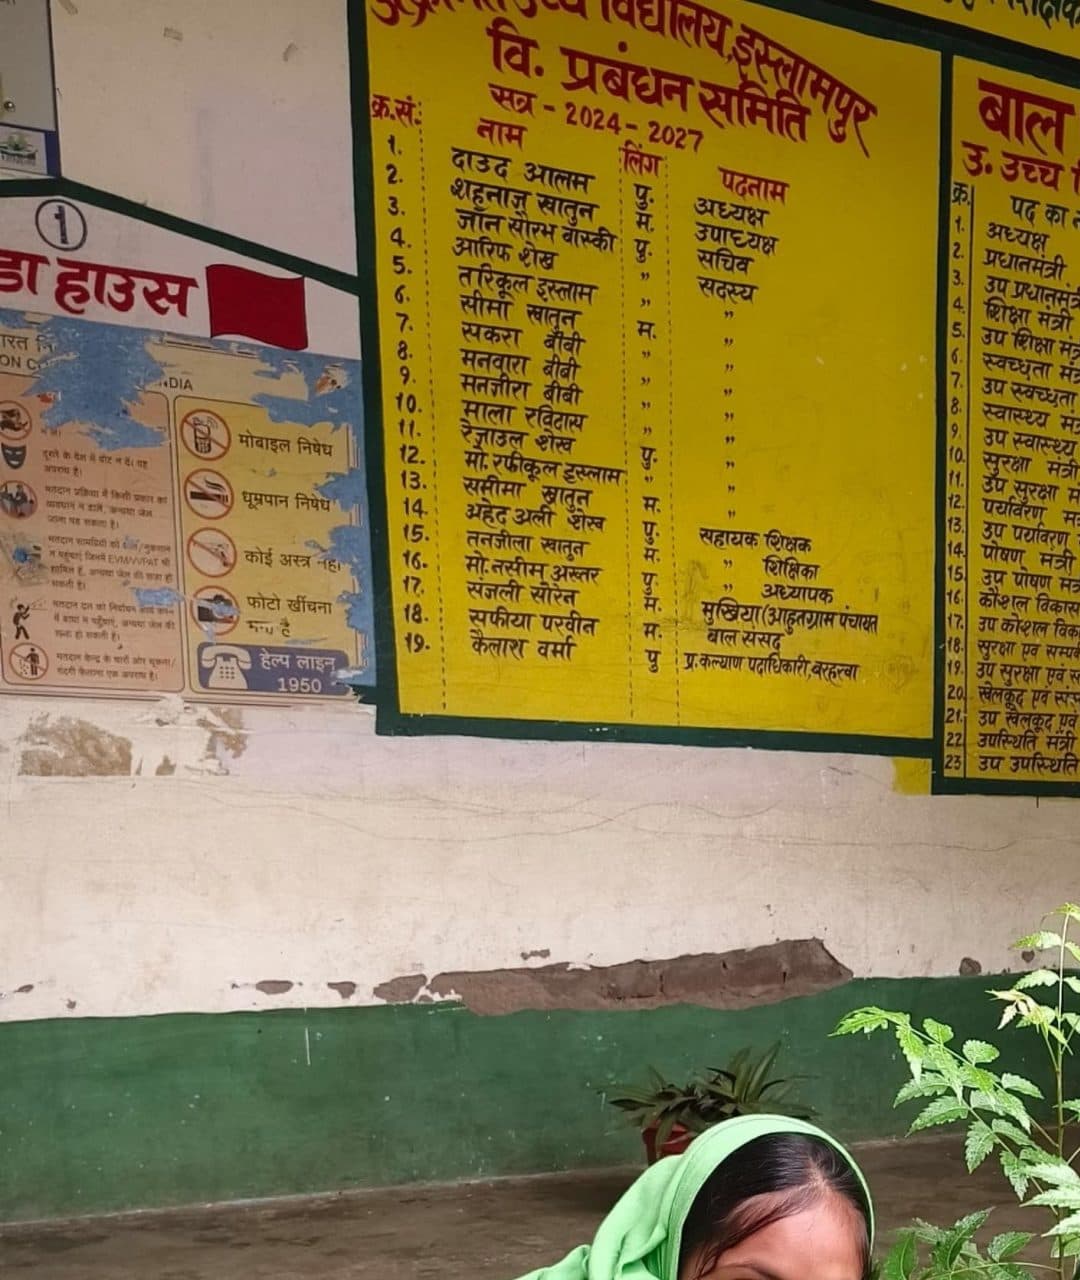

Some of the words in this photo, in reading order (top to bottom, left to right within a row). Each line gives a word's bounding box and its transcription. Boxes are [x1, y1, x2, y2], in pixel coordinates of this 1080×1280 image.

[485, 16, 544, 78] वि.
[559, 40, 695, 112] प्रबंधन
[698, 76, 812, 142] समिति
[488, 83, 538, 115] सत्र
[977, 78, 1076, 156] बाल
[387, 134, 402, 155] 1.
[477, 118, 528, 149] नाम
[451, 147, 512, 180] दाउद
[523, 162, 596, 194] आलम
[619, 139, 664, 176] लिंग
[961, 141, 993, 177] उ.
[1000, 151, 1065, 191] उच्च
[386, 163, 403, 184] 2.
[718, 167, 790, 203] पदनाम
[694, 197, 770, 227] अध्यक्ष
[1010, 195, 1041, 227] पद
[1045, 203, 1070, 227] का
[54, 205, 69, 245] 1
[390, 227, 412, 248] 4.
[452, 236, 514, 262] आरिफ
[697, 247, 755, 275] सचिव
[54, 257, 199, 317] हाउस
[394, 284, 410, 304] 6.
[696, 276, 759, 304] सदस्य
[984, 275, 1011, 297] उप
[460, 289, 514, 321] सीमा
[1037, 304, 1074, 332] मंत्री
[543, 326, 586, 355] बीबी
[981, 326, 1009, 346] उप
[397, 340, 413, 361] 8.
[542, 353, 581, 381] बीबी
[395, 392, 422, 414] 10.
[543, 380, 584, 405] बीबी
[461, 399, 517, 425] माला
[238, 429, 291, 454] मोबाइल
[297, 436, 333, 457] निषेध
[399, 444, 425, 464] 12.
[464, 443, 489, 471] मो.
[241, 490, 289, 510] धूम्रपान
[295, 493, 332, 512] निषेध
[512, 504, 557, 527] अली
[699, 527, 760, 548] सहायक
[763, 529, 812, 553] शिक्षक
[243, 546, 273, 568] कोई
[279, 554, 312, 568] अस्त्र
[464, 550, 490, 575] मो.
[762, 554, 820, 581] शिक्षिका
[1040, 546, 1076, 573] मंत्री
[246, 592, 281, 611] फोटो
[286, 595, 332, 614] खींचना
[761, 584, 834, 605] अध्यापक
[701, 597, 763, 626] मुखिया
[404, 632, 430, 653] 19.
[469, 628, 529, 660] कैलाश
[537, 635, 577, 660] वर्मा
[707, 628, 741, 646] बाल
[742, 625, 785, 654] संसद
[259, 648, 290, 670] हेल्प
[297, 655, 337, 673] लाइन
[278, 677, 322, 693] 1950
